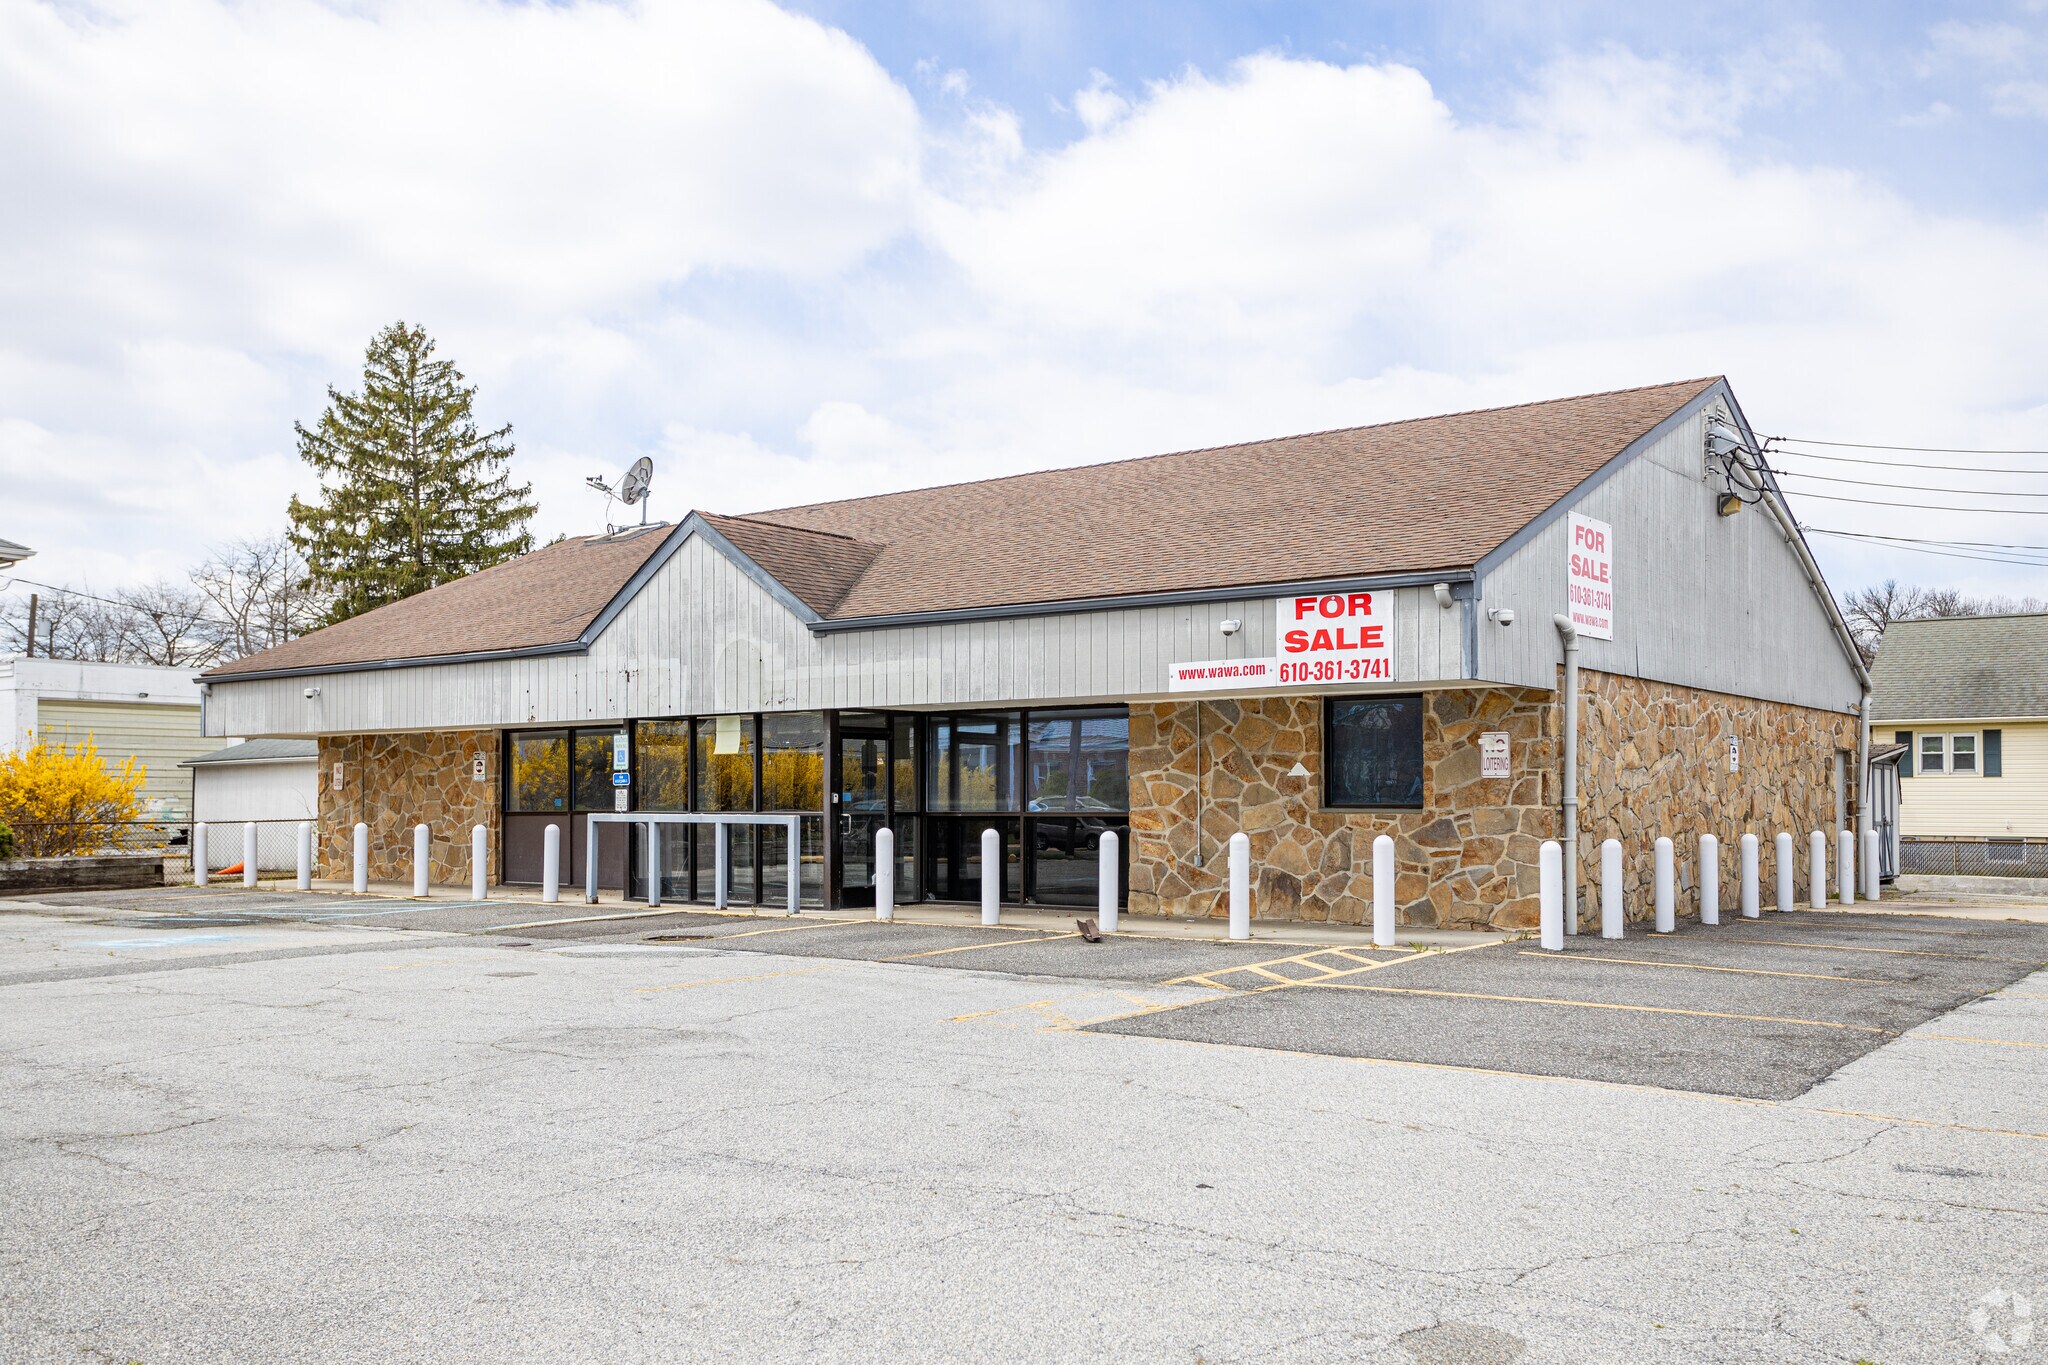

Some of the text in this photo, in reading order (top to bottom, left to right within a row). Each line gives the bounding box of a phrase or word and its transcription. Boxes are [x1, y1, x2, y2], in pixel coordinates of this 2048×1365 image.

[1575, 525, 1605, 553] FOR
[1571, 554, 1609, 583] SALE
[1295, 593, 1372, 620] FOR
[1570, 584, 1611, 611] 610-361-3741
[1572, 612, 1609, 629] www.wawa.com
[1284, 625, 1384, 653] SALE
[1178, 664, 1266, 680] www.wawa.com
[1279, 658, 1390, 683] 610-361-3741
[1484, 757, 1509, 770] LOITERING
